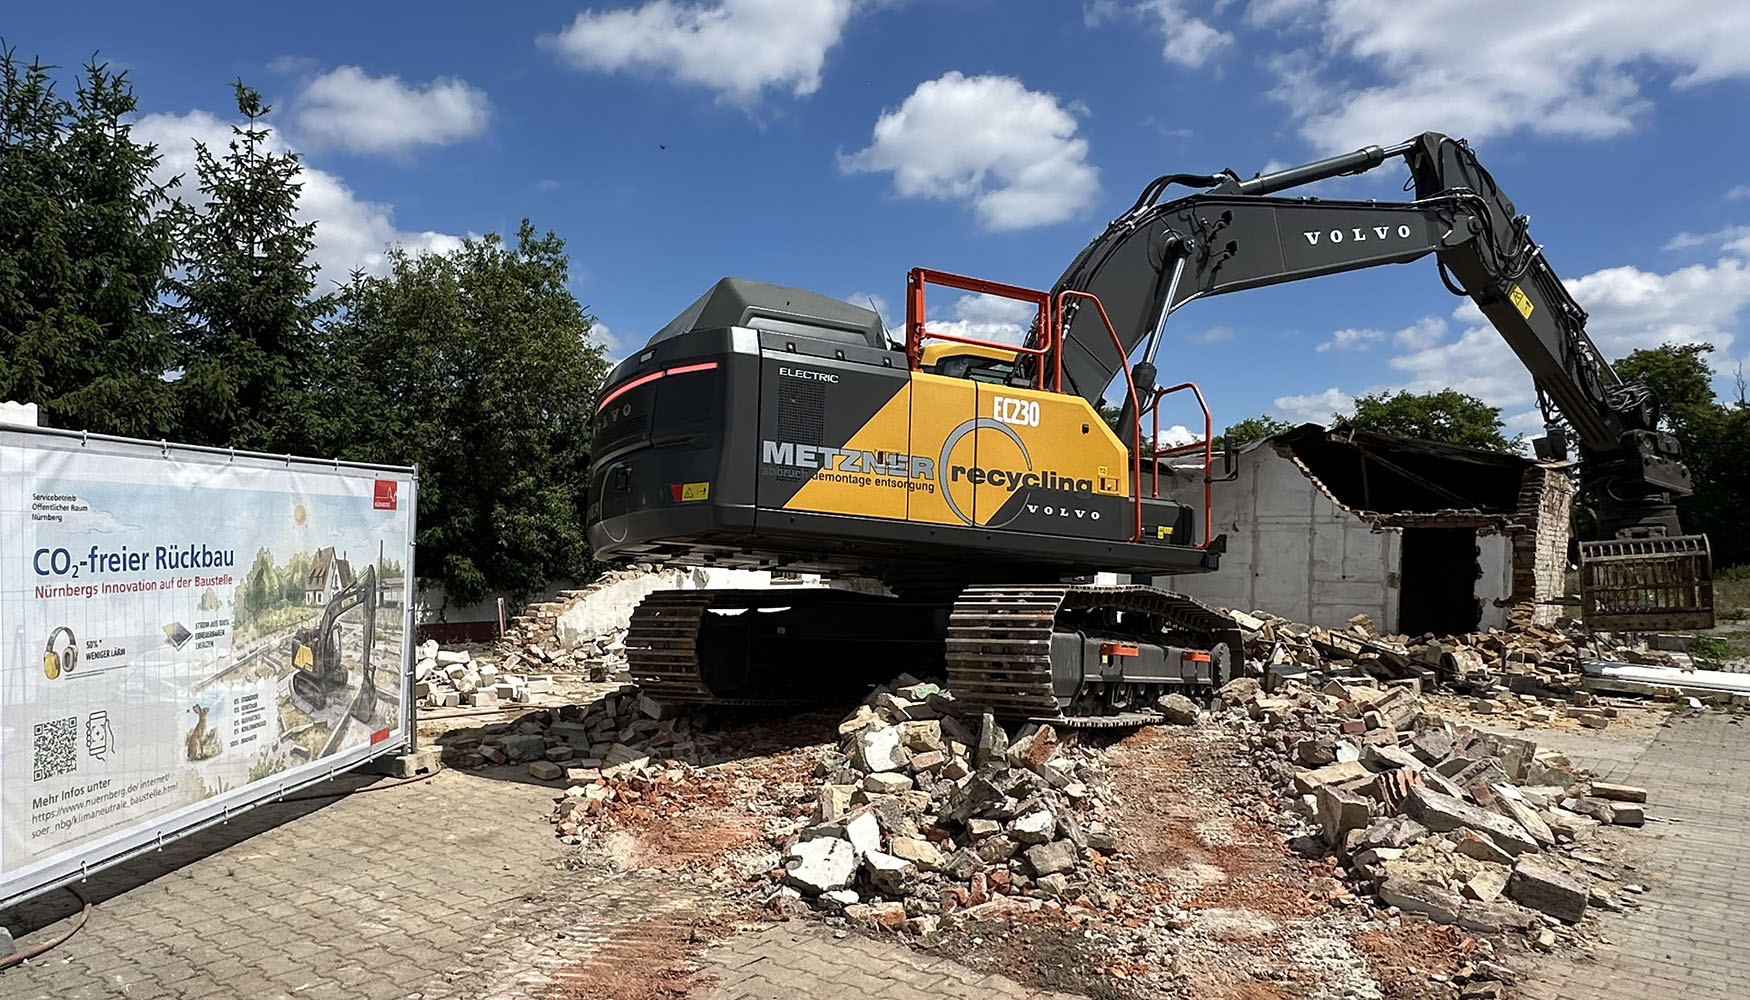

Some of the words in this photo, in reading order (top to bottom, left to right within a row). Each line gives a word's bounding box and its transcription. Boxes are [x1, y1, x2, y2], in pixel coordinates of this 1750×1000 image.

[1304, 225, 1411, 245] VOLVO
[778, 367, 840, 384] ELECTRIC
[993, 396, 1040, 427] EC230
[762, 440, 935, 480] METZNER
[812, 472, 873, 488] demontage
[874, 478, 936, 494] entsorgung
[32, 493, 77, 502] Servicebetrieb
[32, 513, 63, 522] Nürnberg
[71, 504, 88, 512] Raum
[1026, 503, 1101, 520] VOLVO
[155, 544, 234, 570] Rückbau
[35, 582, 98, 600] Nürnbergs
[101, 579, 157, 594] Innovation
[159, 576, 174, 590] auf
[177, 576, 192, 588] der
[194, 574, 233, 587] Baustelle
[86, 651, 110, 661] WENIGER
[32, 794, 59, 810] Mehr
[61, 787, 85, 801] Infos
[87, 779, 112, 793] unter
